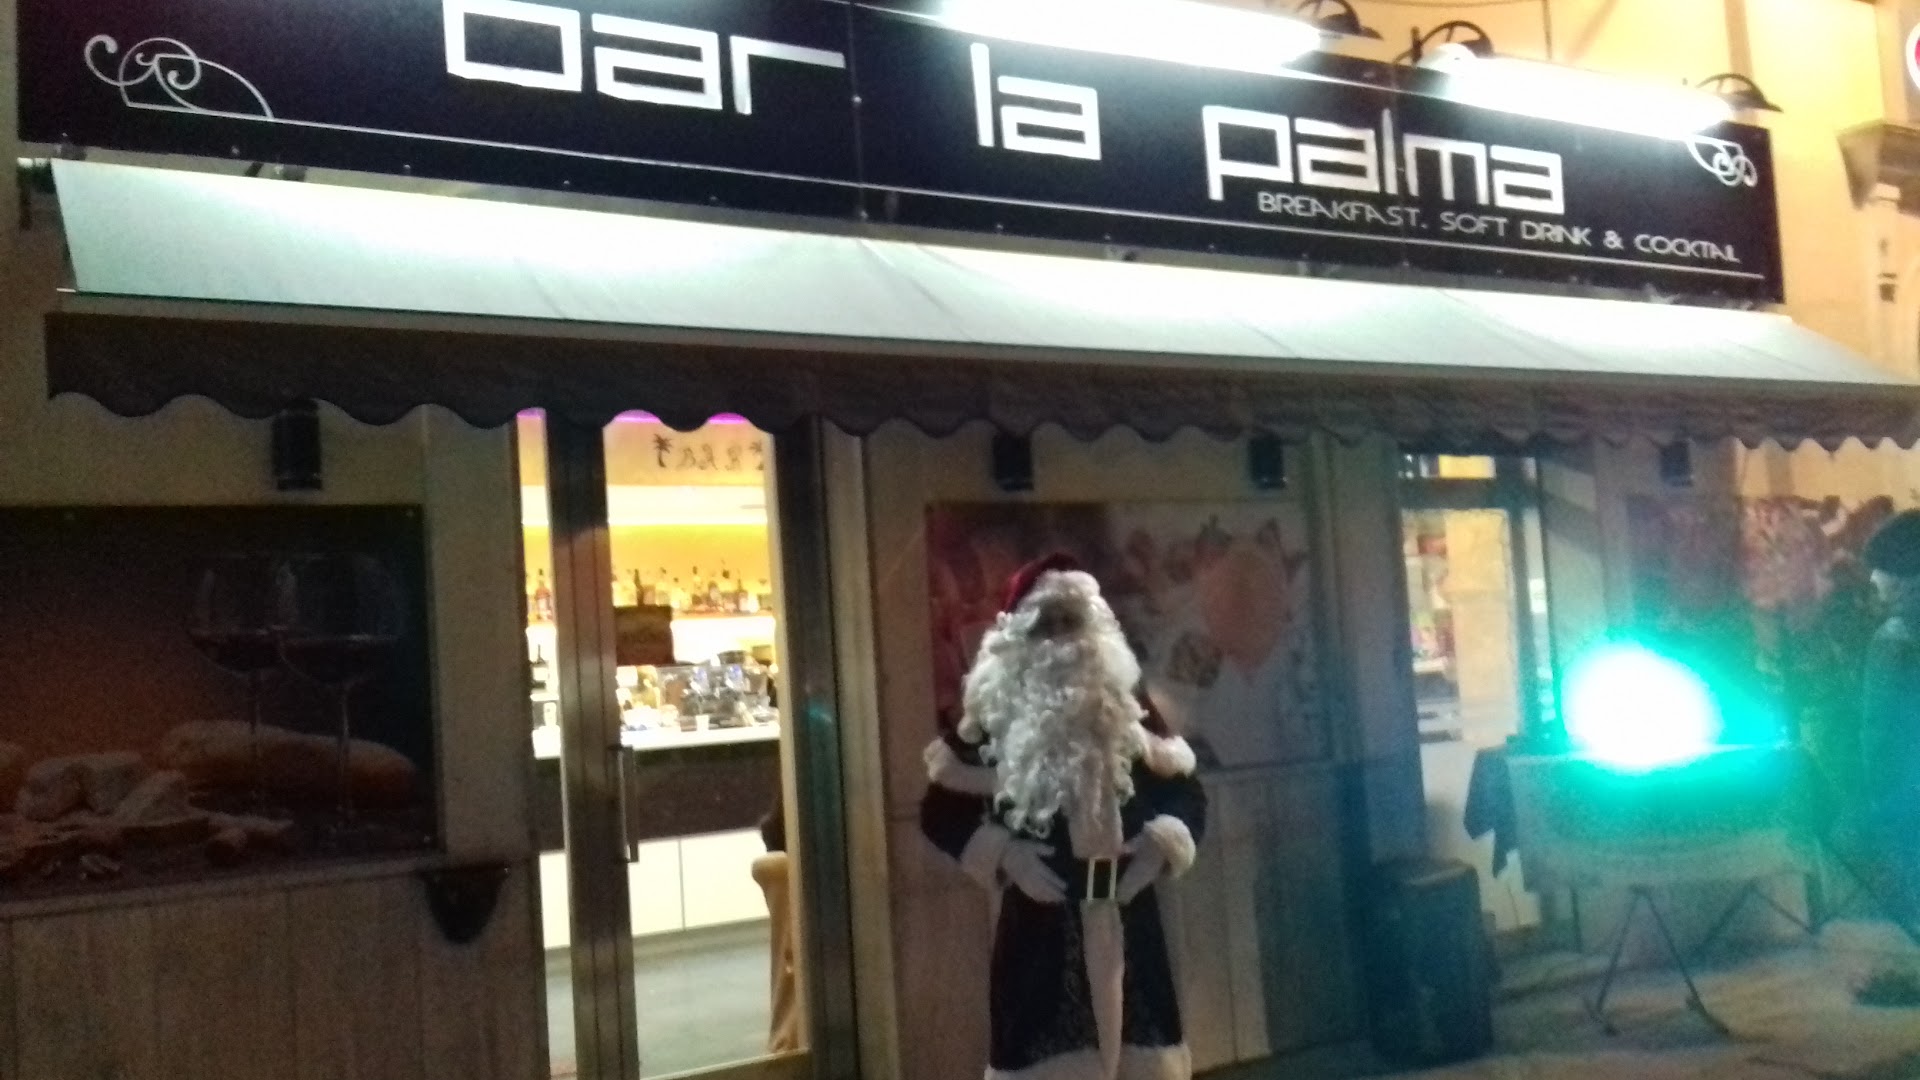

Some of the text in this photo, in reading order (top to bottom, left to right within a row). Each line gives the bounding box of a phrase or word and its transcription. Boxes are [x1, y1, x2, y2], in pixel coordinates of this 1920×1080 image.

[970, 43, 1101, 160] la
[1203, 105, 1565, 214] palma
[1257, 191, 1427, 229] BREAKFAST.
[1440, 211, 1508, 236] SOFT
[1520, 219, 1592, 246] DRINK
[1603, 230, 1624, 249] &
